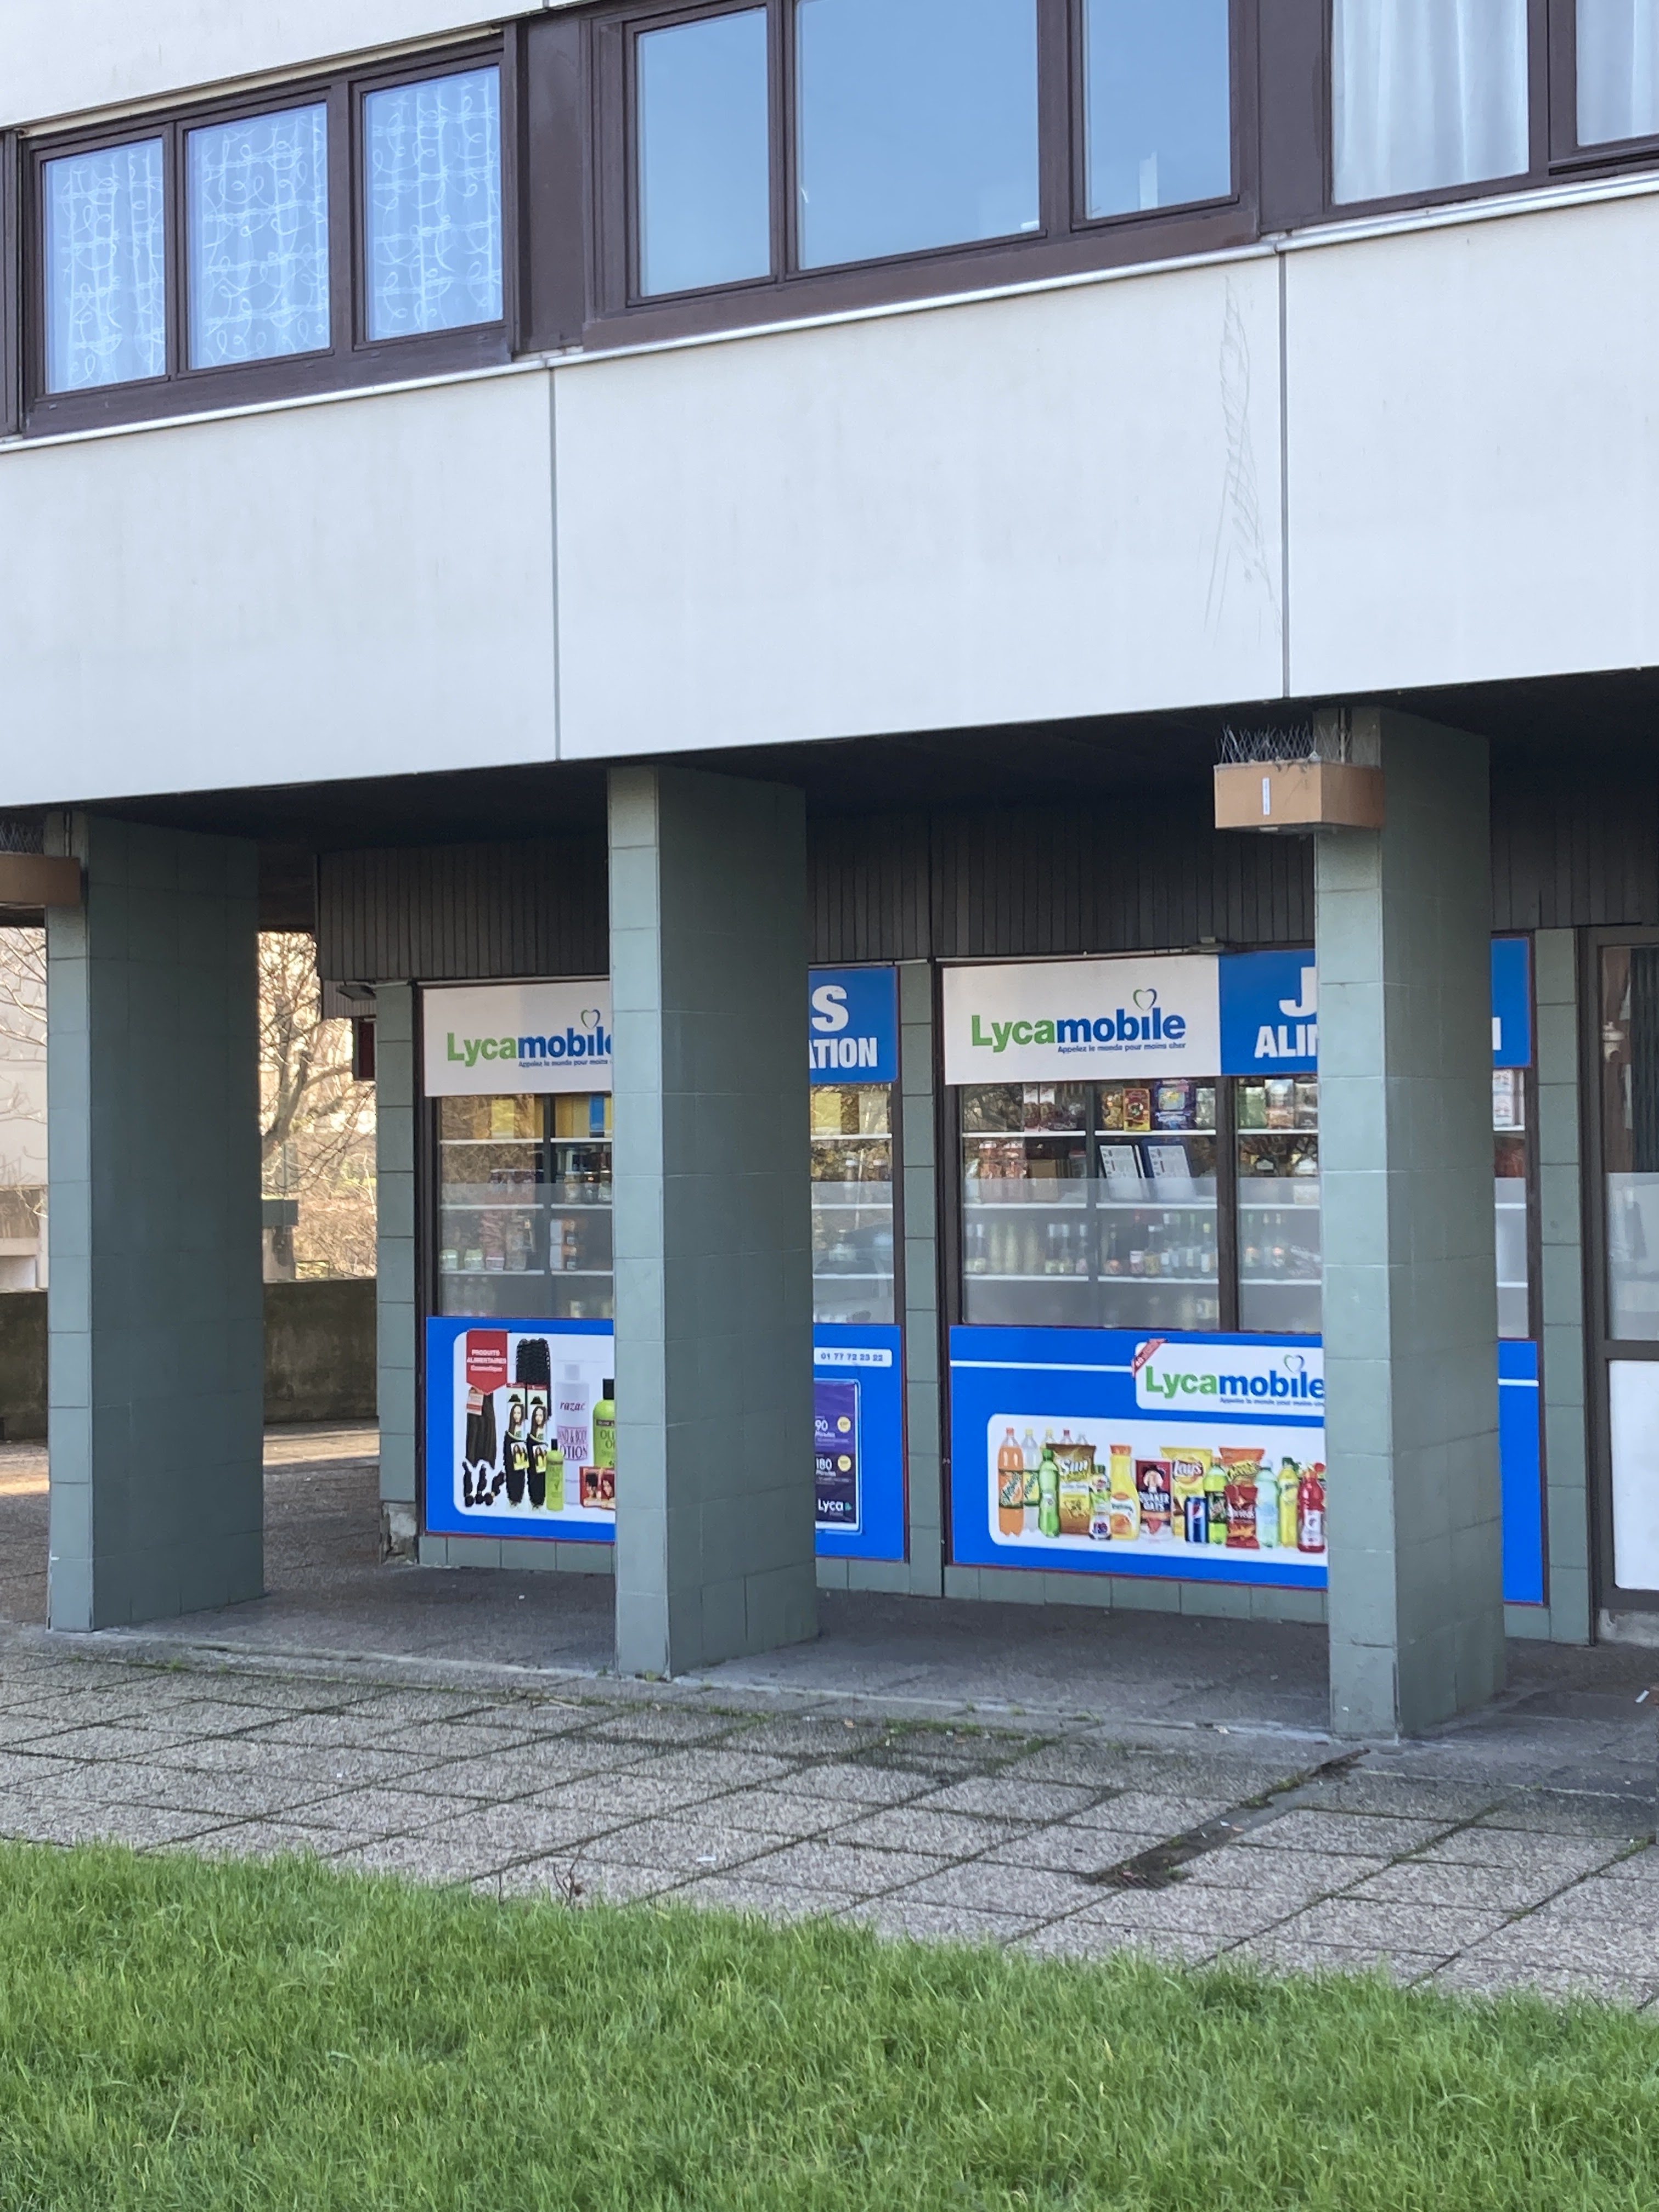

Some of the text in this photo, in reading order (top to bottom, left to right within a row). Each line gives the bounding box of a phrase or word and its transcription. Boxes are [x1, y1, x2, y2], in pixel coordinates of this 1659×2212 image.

[811, 985, 849, 1032] S
[971, 1007, 1186, 1053] Lycamobile
[447, 1026, 611, 1068] Lycamobil
[1058, 1046, 1087, 1054] Appelez
[821, 1352, 831, 1361] 01
[834, 1352, 844, 1361] 77
[817, 1498, 844, 1513] Lyca
